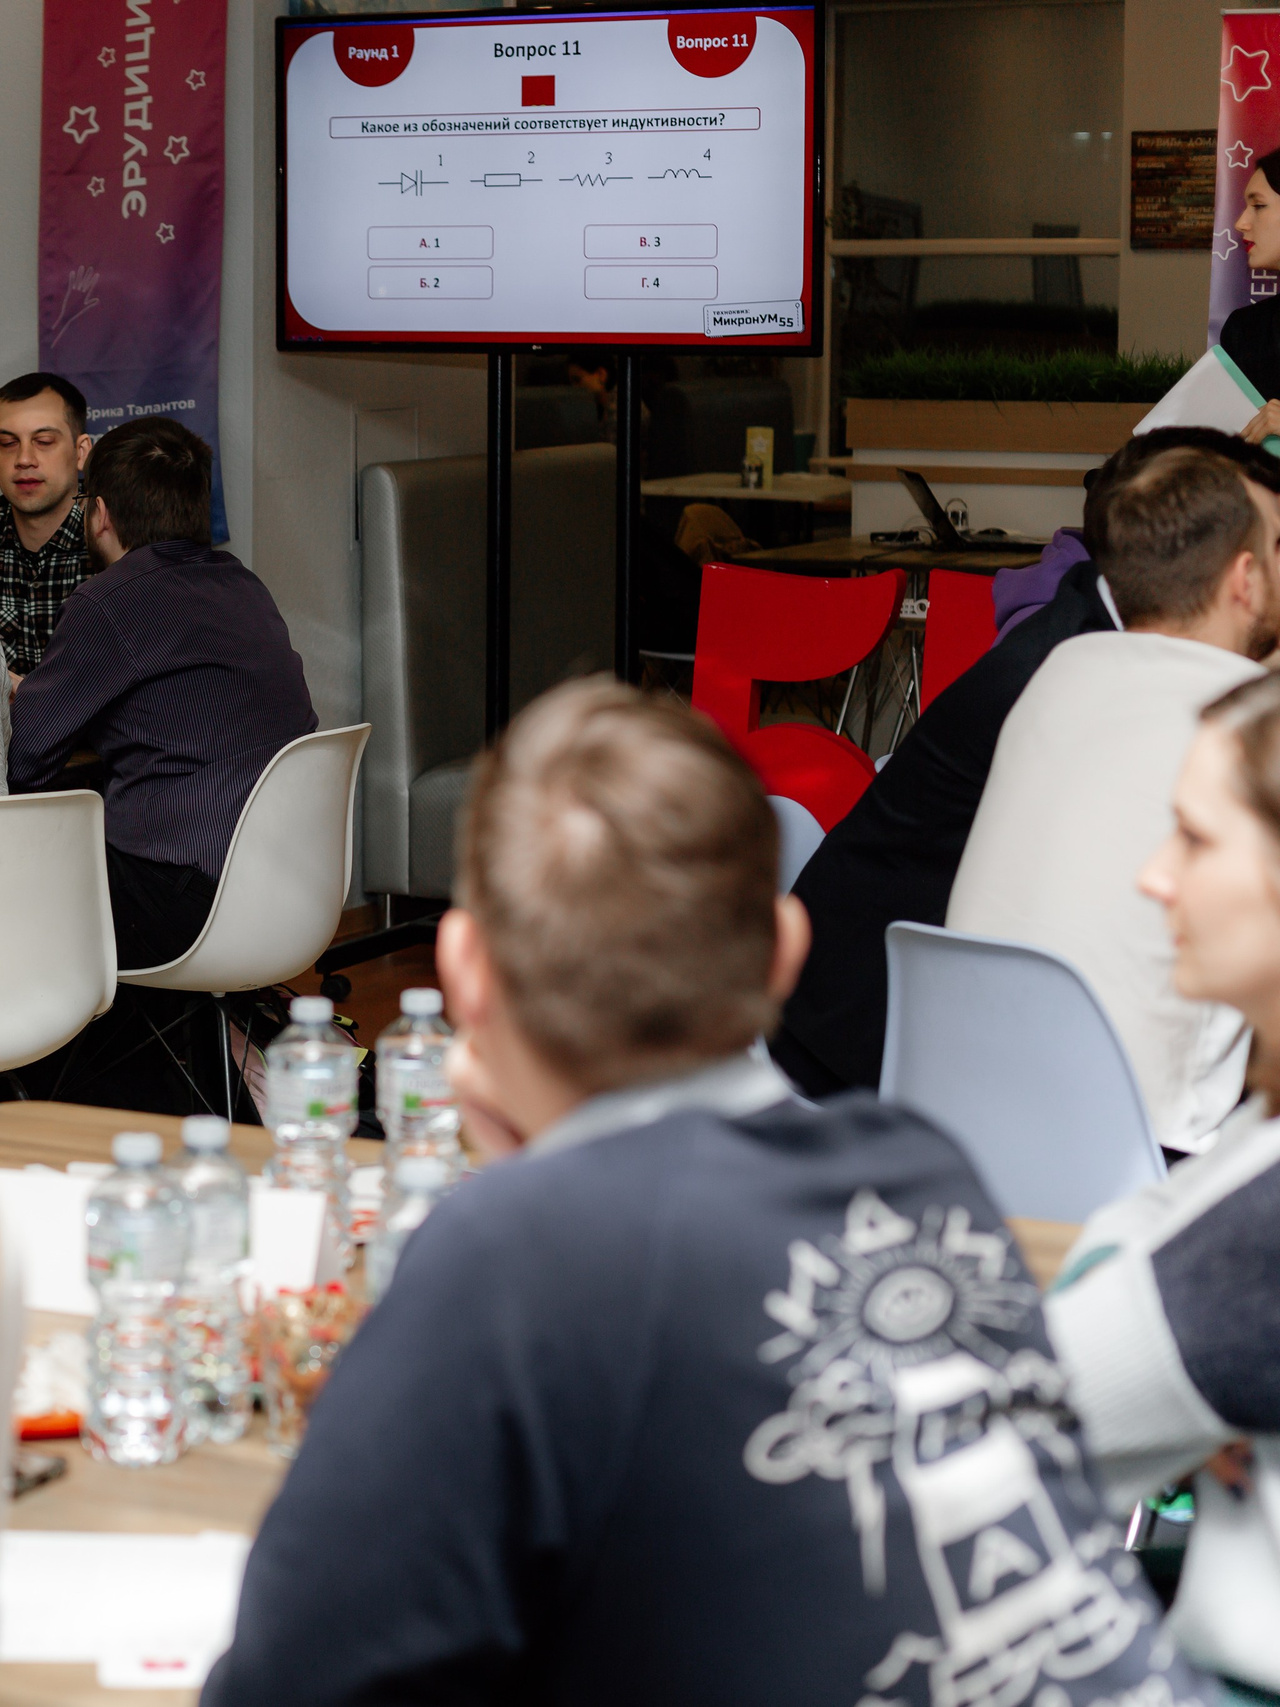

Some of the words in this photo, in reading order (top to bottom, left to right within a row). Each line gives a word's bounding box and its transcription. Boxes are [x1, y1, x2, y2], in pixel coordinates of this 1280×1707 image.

[676, 35, 728, 51] Вопрос
[731, 33, 749, 48] 11
[348, 46, 389, 62] Раунд
[391, 44, 400, 58] 1
[494, 42, 557, 60] Вопрос
[561, 40, 582, 56] 11
[121, 0, 155, 220] ЭРУДИЦИ
[361, 121, 400, 134] Какое
[403, 122, 418, 132] из
[422, 117, 511, 132] обозначений
[514, 118, 608, 131] соответствует
[612, 112, 726, 131] индуктивности?
[438, 154, 443, 167] 1
[527, 151, 535, 164] 2
[604, 152, 613, 165] 3
[703, 148, 712, 161] 4
[419, 238, 431, 249] А.
[434, 238, 440, 248] 1
[639, 237, 651, 248] В.
[653, 236, 661, 248] 3
[419, 278, 431, 289] Б.
[433, 277, 440, 288] 2
[641, 277, 650, 288] Г.
[652, 277, 660, 288] 4
[126, 399, 196, 416] Талантов
